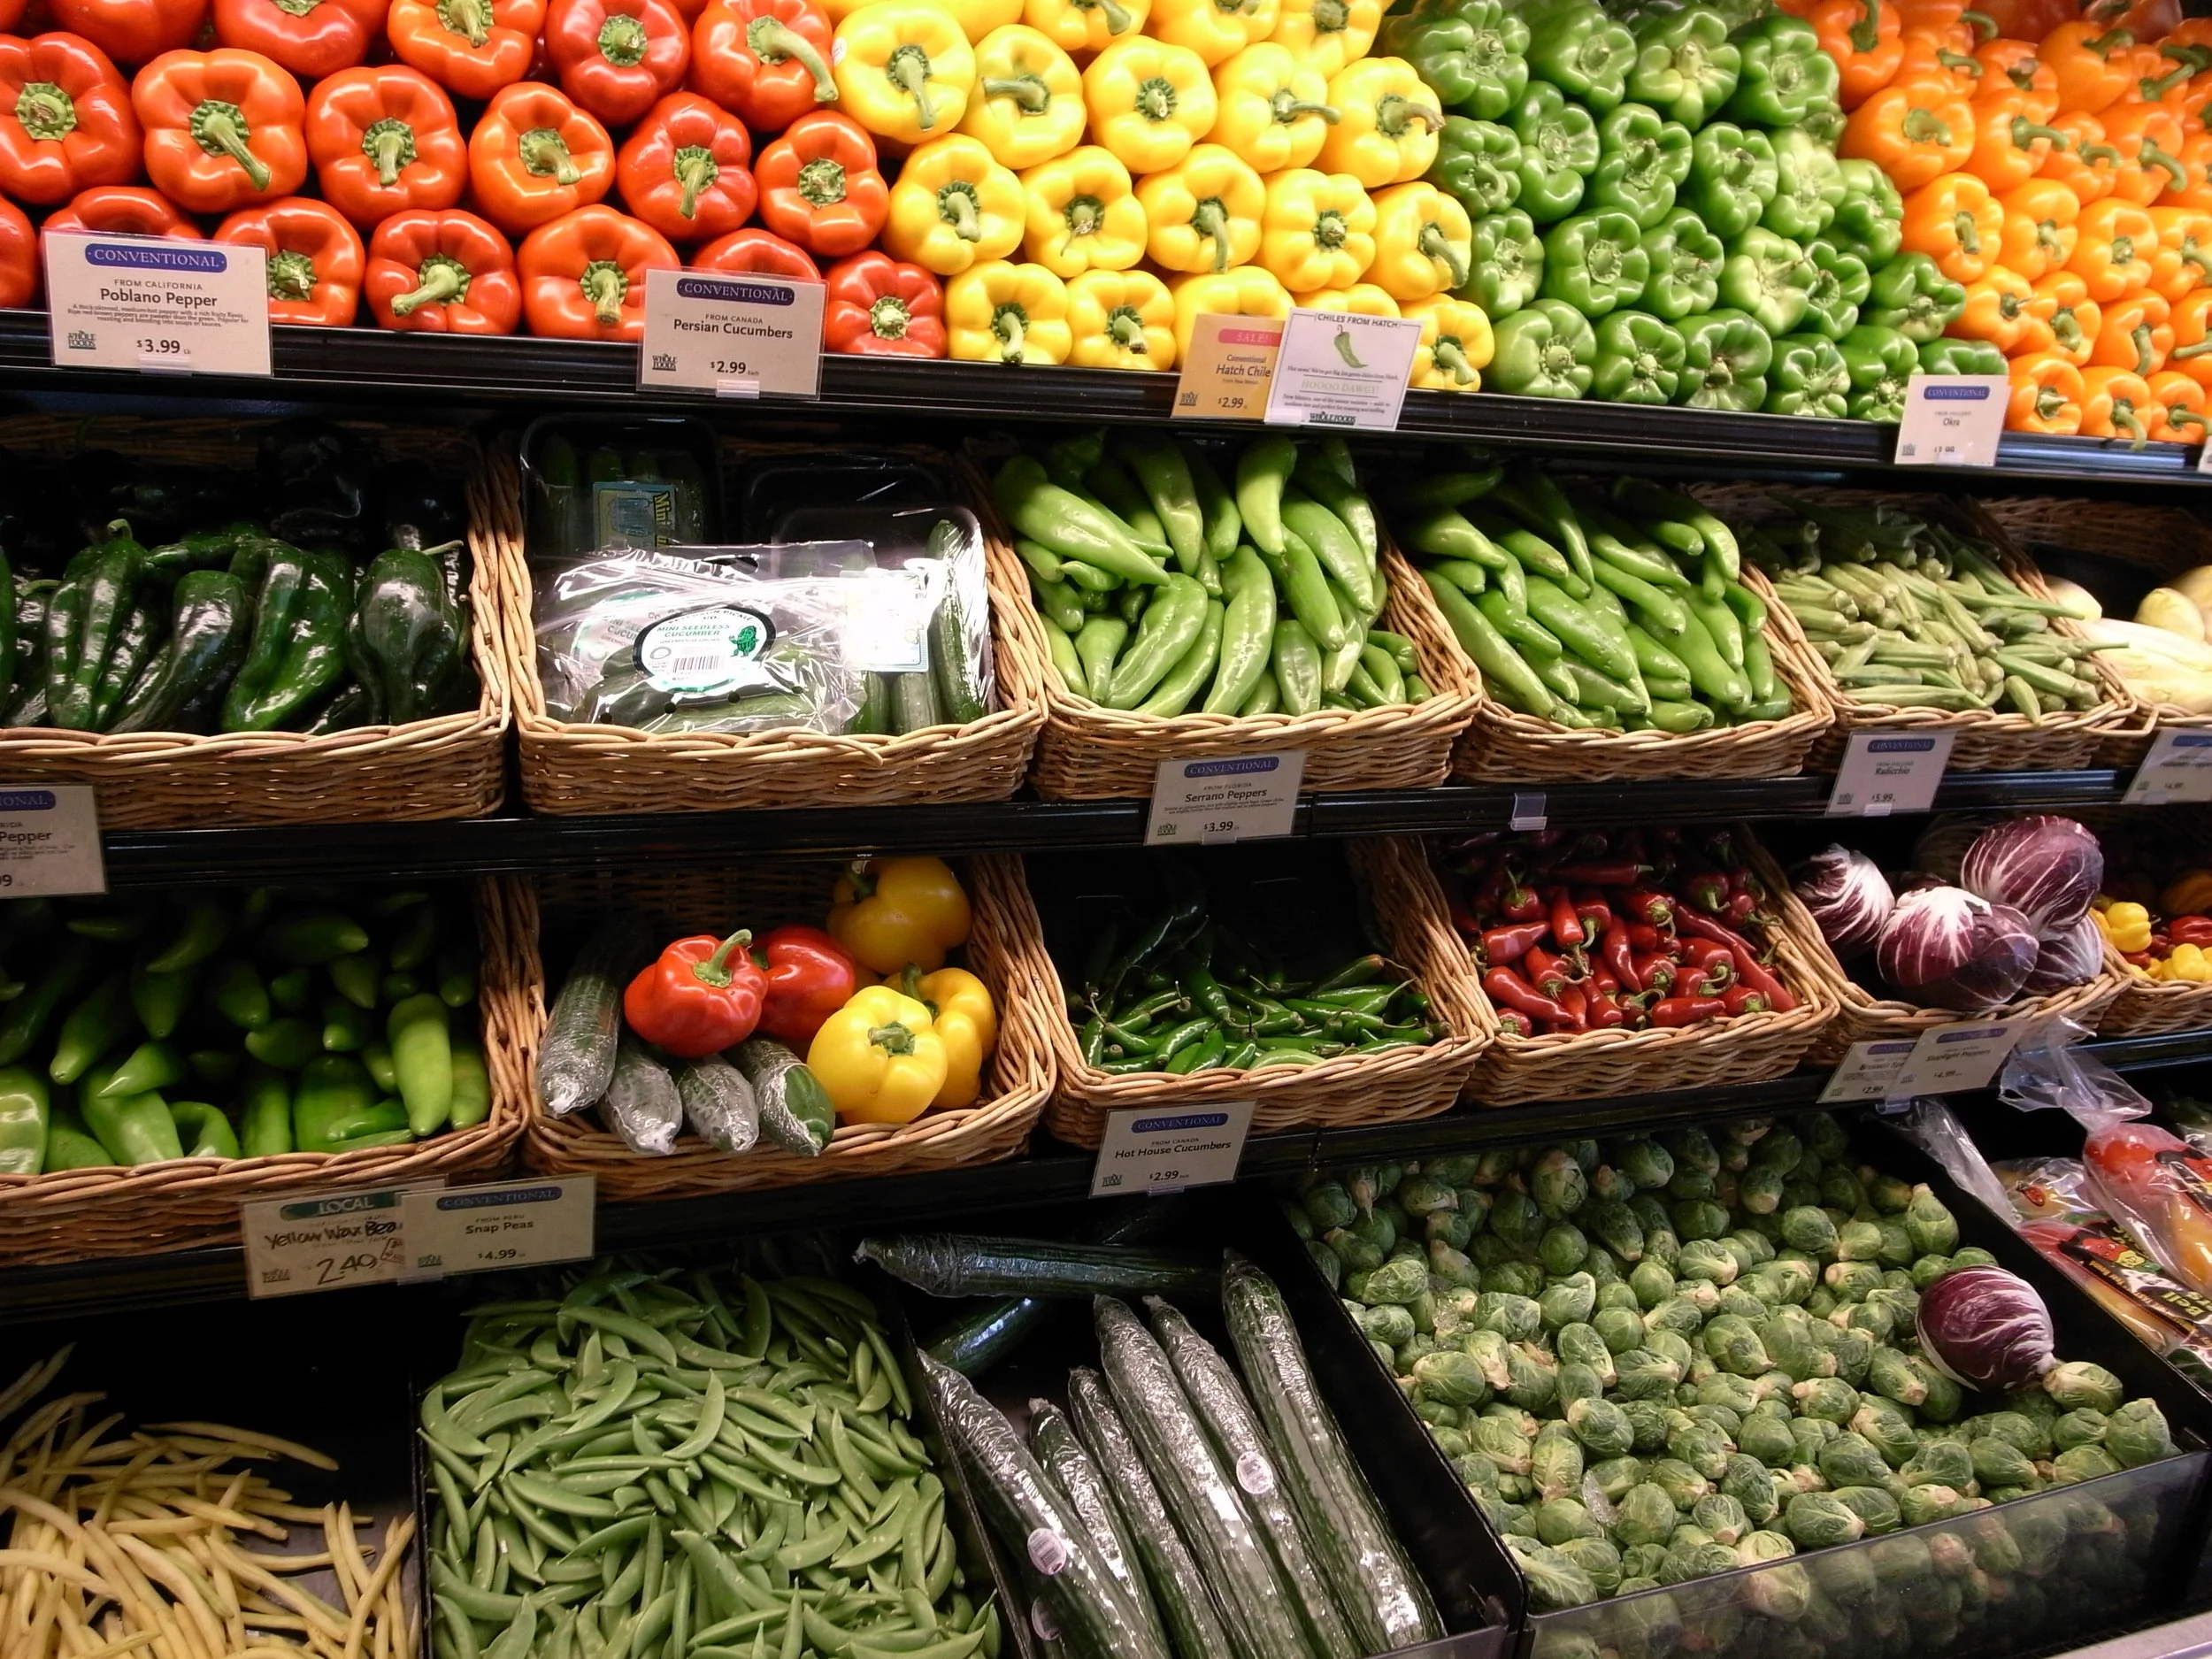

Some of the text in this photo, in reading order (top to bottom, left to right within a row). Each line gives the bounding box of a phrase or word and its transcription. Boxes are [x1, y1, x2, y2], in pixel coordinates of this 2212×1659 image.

[94, 249, 219, 267] CONVENTIONAL
[145, 280, 203, 290] CALIFORNIA
[684, 282, 788, 302] CONVENTIONAL
[100, 288, 218, 309] Poblano Pepper
[705, 313, 764, 324] FROM CANADA
[1317, 312, 1399, 328] CHILES FROM HATCH
[673, 319, 793, 339] Persian Cucumbers
[136, 338, 180, 353] $3.99
[710, 360, 747, 374] $2.99
[1216, 364, 1271, 378] Hatch Chile
[1927, 388, 1986, 397] CONVENTIONAL
[1217, 396, 1244, 409] $2.99
[1942, 417, 1961, 427] Okra
[1871, 740, 1931, 750] CONVENTIONAL
[1190, 759, 1273, 775] CONVENTIONAL
[1874, 766, 1910, 775] Radicchio
[1185, 788, 1267, 803] Serrano Peppers
[1203, 820, 1233, 833] $3.99
[0, 832, 52, 845] Pepper
[1137, 1116, 1221, 1130] CONVENTIONAL
[1115, 1141, 1232, 1159] Hot House Cucumbers
[1149, 1170, 1179, 1182] $2.99
[319, 1196, 374, 1215] LOCAL
[444, 1190, 557, 1208] CONVENTIONAL
[465, 1220, 534, 1235] Snap Peas
[265, 1231, 321, 1250] Yellow
[325, 1225, 362, 1240] Wax
[478, 1248, 517, 1261] $4.99
[2161, 1291, 2206, 1317] Bell
